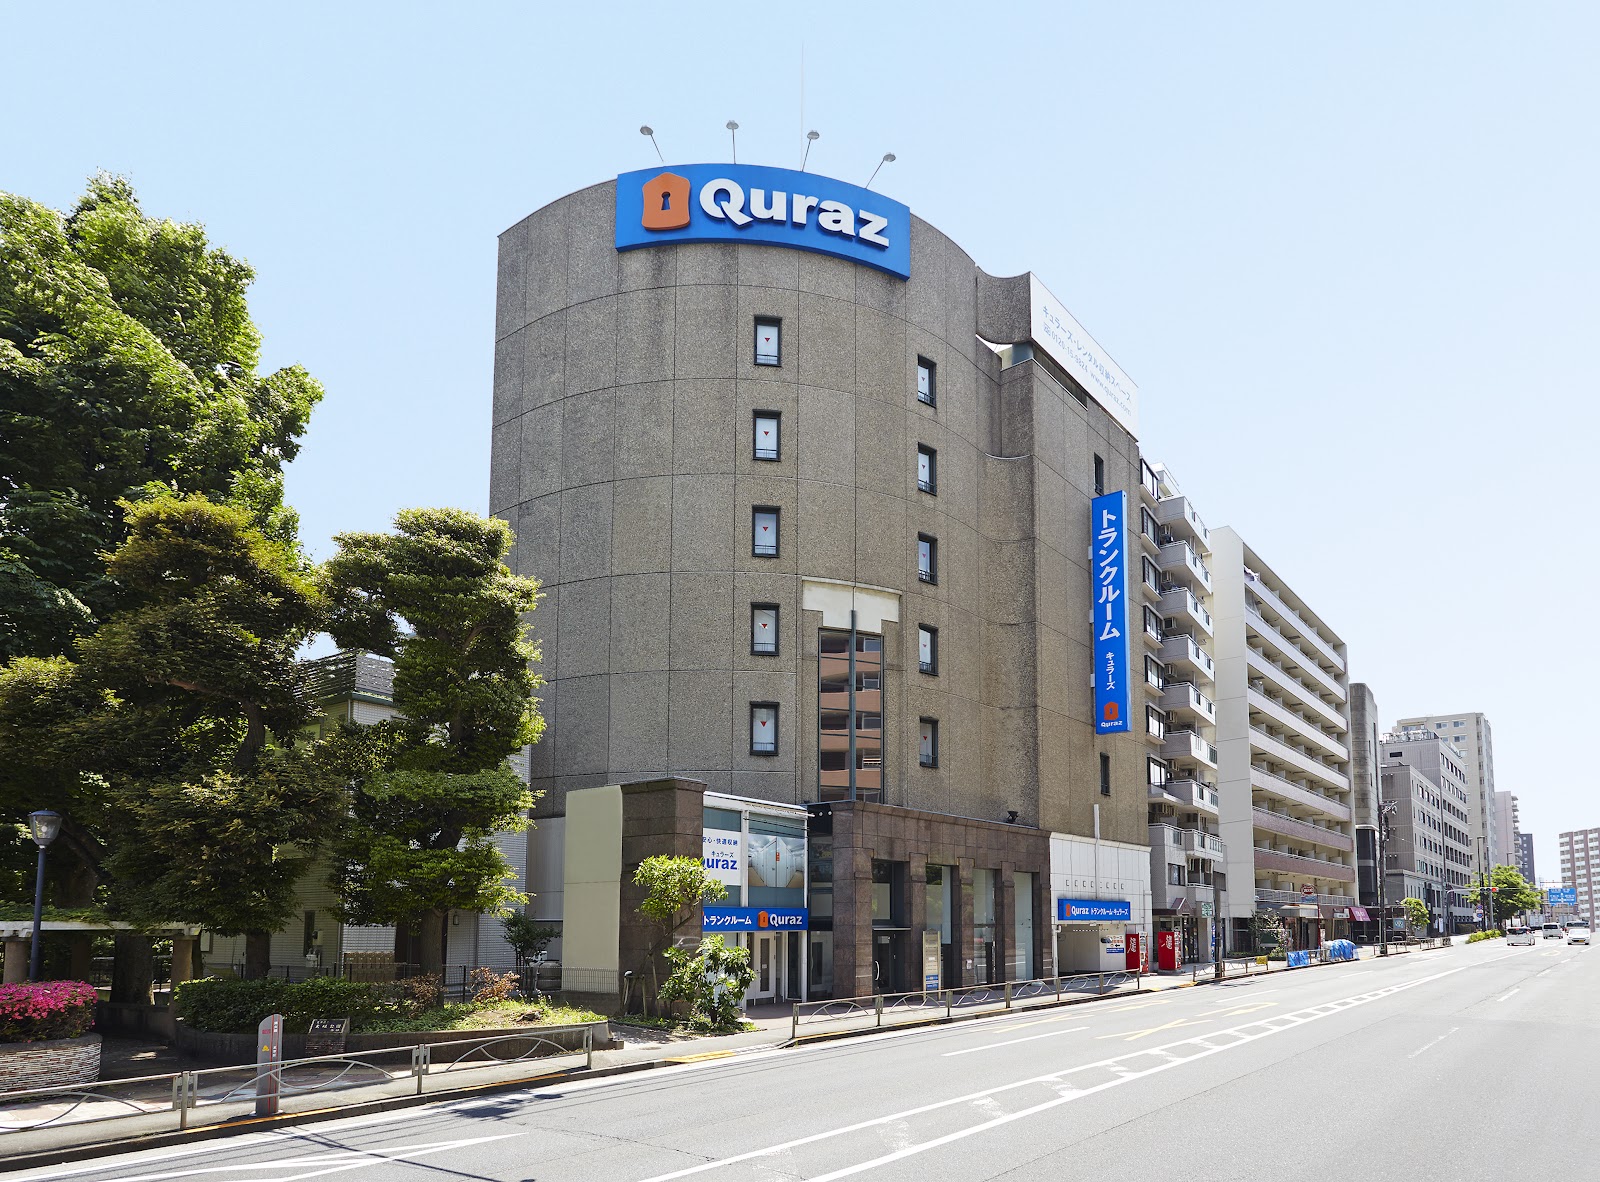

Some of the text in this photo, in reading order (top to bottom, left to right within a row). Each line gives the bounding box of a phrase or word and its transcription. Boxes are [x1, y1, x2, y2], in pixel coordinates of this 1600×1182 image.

[699, 178, 890, 248] Quraz
[1097, 509, 1121, 642] トランクルーム
[1105, 651, 1116, 690] キュラーズ
[703, 916, 752, 925] トランクルーム
[770, 913, 803, 927] Quraz
[1071, 906, 1089, 916] Quraz
